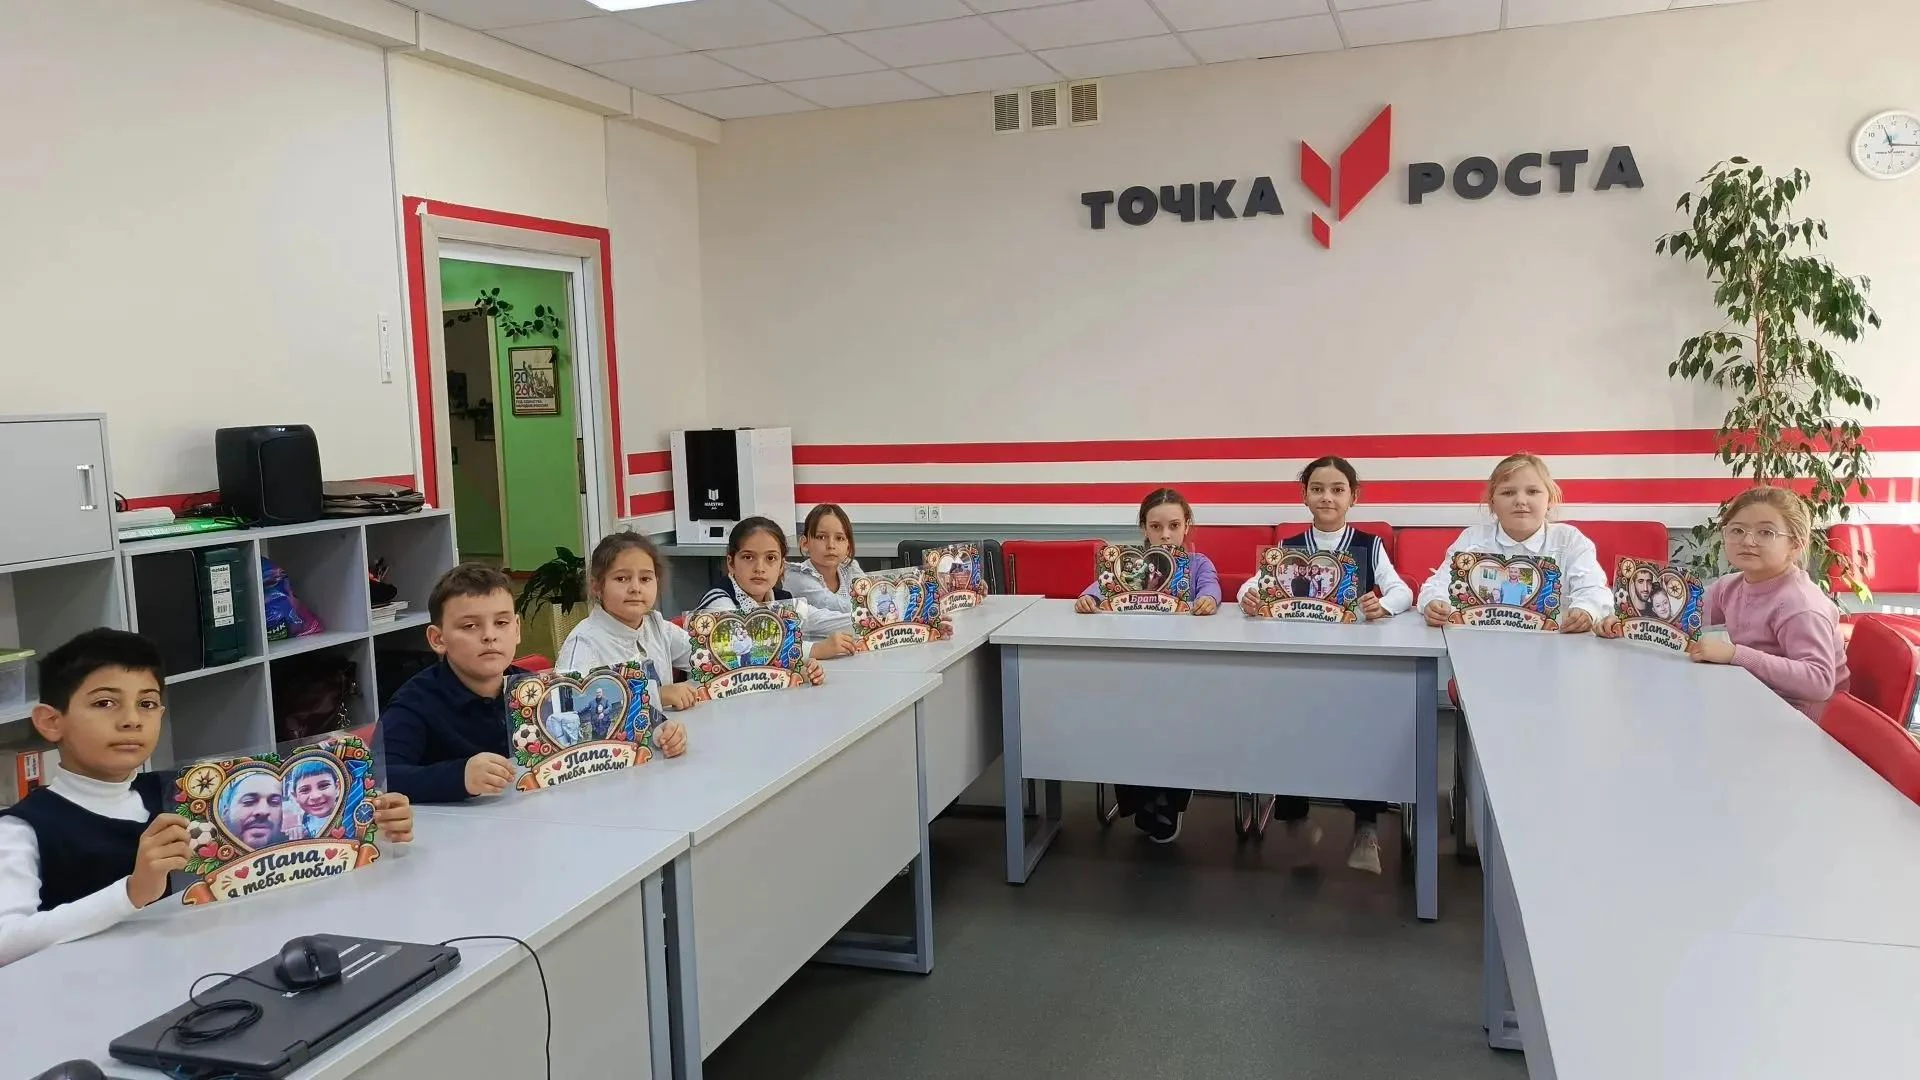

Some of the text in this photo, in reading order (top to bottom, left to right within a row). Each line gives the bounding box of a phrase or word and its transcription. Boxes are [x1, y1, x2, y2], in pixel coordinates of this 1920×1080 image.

[1081, 145, 1645, 230] ТОЧКА РОСТА
[514, 371, 528, 384] 20
[515, 384, 528, 396] 26
[1290, 601, 1325, 613] Папа,
[1485, 608, 1524, 620] Папа,
[1306, 613, 1337, 622] люблю!
[1502, 620, 1537, 630] люблю!
[1639, 621, 1671, 640] Папа,
[880, 638, 898, 648] тебя
[899, 635, 925, 644] люблю!
[1633, 633, 1653, 642] тебя
[1653, 635, 1682, 651] люблю!
[730, 671, 771, 686] Папа,
[725, 685, 748, 698] тебя
[749, 680, 784, 691] люблю!
[564, 747, 613, 769] Папа,
[547, 759, 629, 786] я тебя люблю!
[252, 848, 325, 877] Папа,
[227, 861, 347, 898] я тебя люблю!
